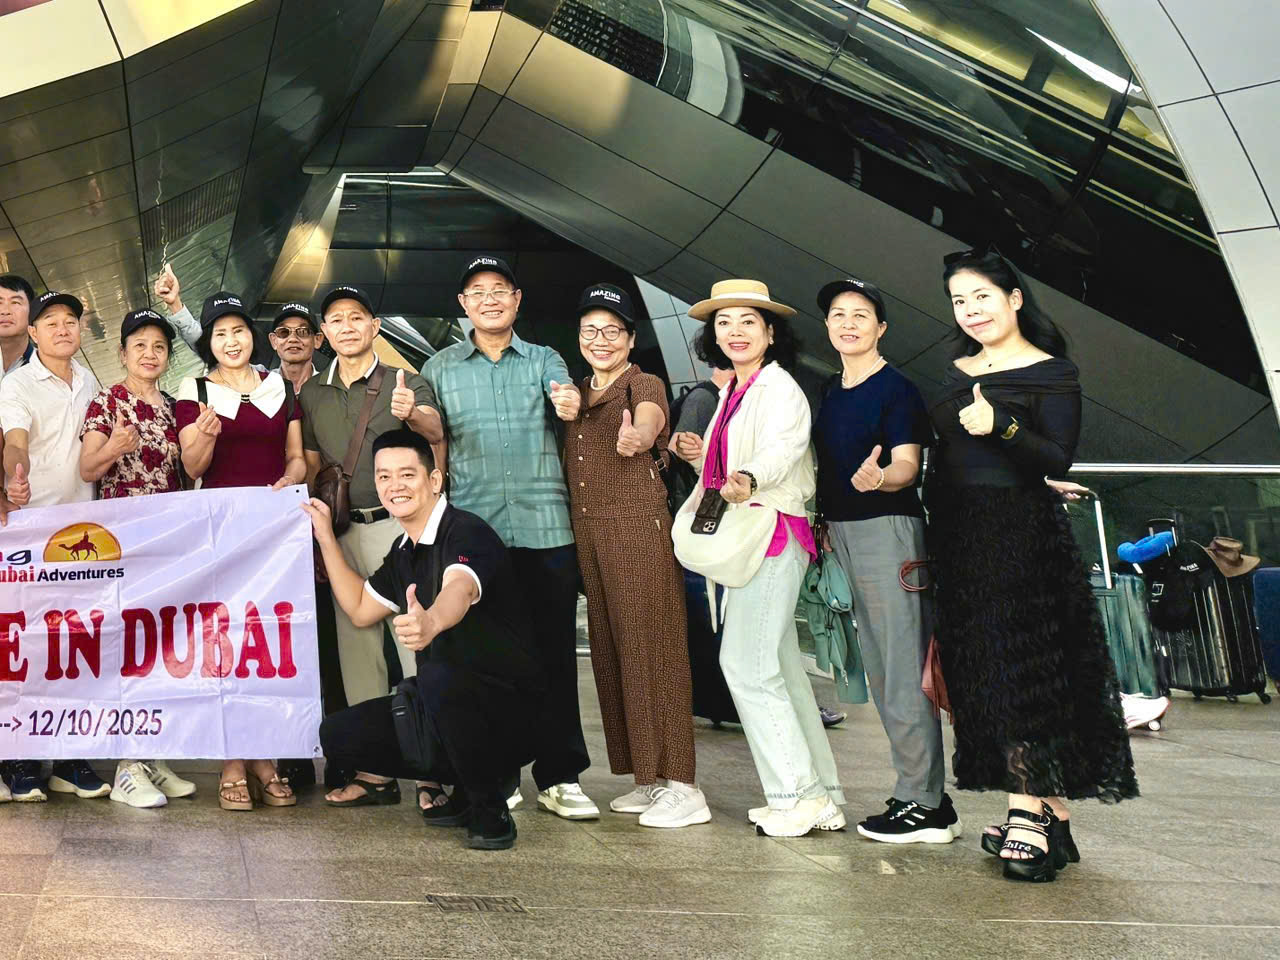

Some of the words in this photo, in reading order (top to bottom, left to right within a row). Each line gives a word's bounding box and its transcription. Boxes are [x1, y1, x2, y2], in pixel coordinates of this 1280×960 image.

[590, 290, 621, 300] AMAZING
[37, 566, 125, 583] Adventures
[43, 608, 105, 681] IN
[120, 600, 297, 680] DUBAI
[28, 708, 163, 737] 12/10/2025
